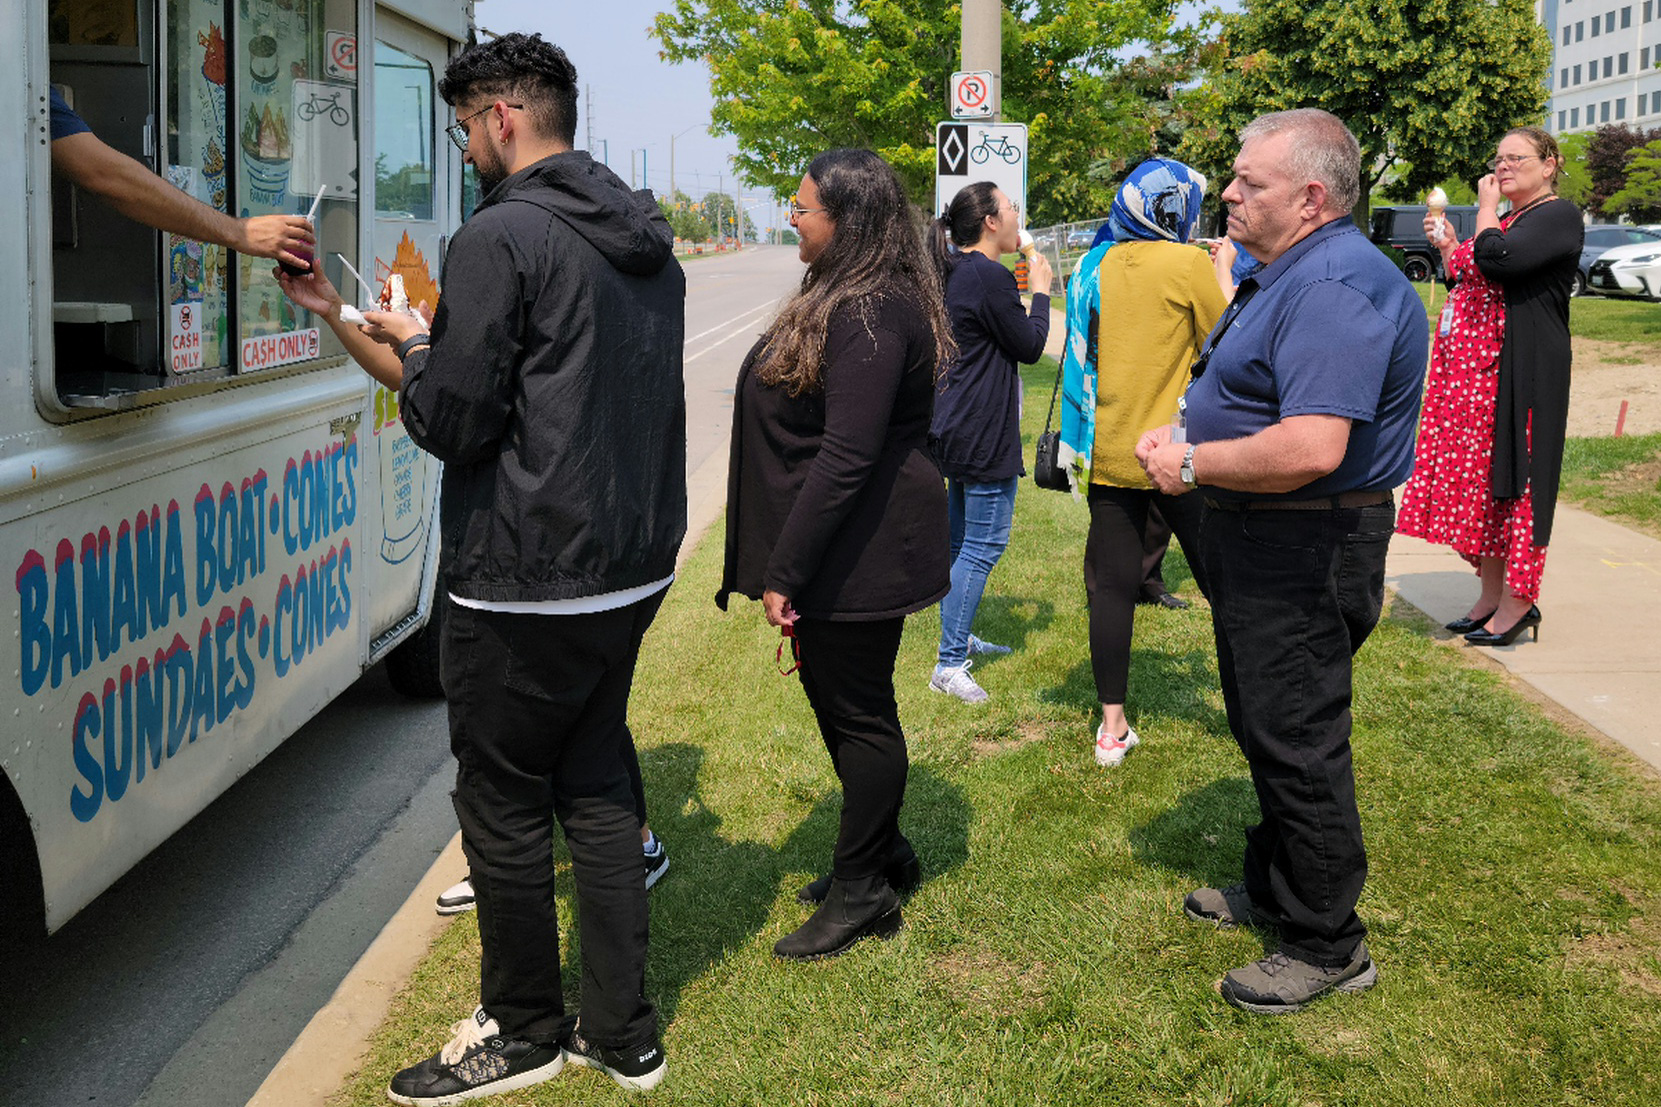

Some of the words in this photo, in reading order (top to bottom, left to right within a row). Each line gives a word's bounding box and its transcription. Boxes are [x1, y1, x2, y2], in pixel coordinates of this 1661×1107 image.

[174, 352, 199, 370] ONLY
[278, 334, 307, 361] ONLY
[16, 499, 187, 696] BANANA
[194, 468, 268, 607] BOAT
[283, 433, 358, 555] CONES
[70, 596, 256, 823] SUNDAES
[273, 537, 352, 678] CONES
